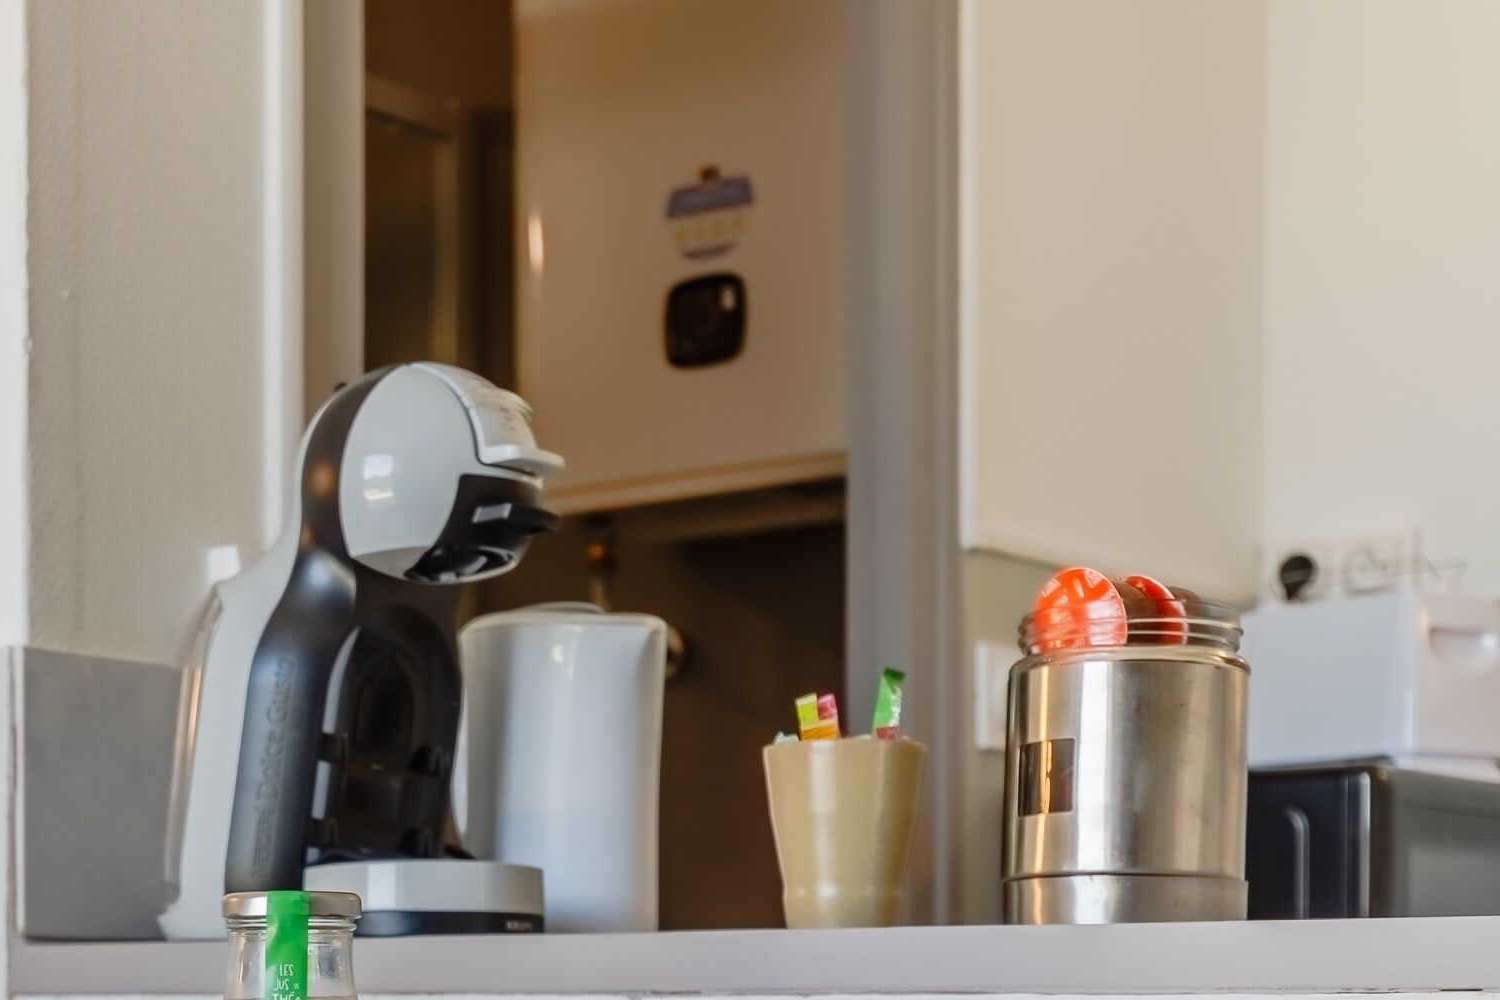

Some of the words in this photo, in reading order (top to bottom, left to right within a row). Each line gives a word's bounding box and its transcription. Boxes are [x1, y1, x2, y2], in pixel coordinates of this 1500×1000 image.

[266, 657, 295, 723] Gusto
[257, 732, 286, 801] Dolce
[275, 978, 289, 991] JUS
[280, 964, 294, 976] LES
